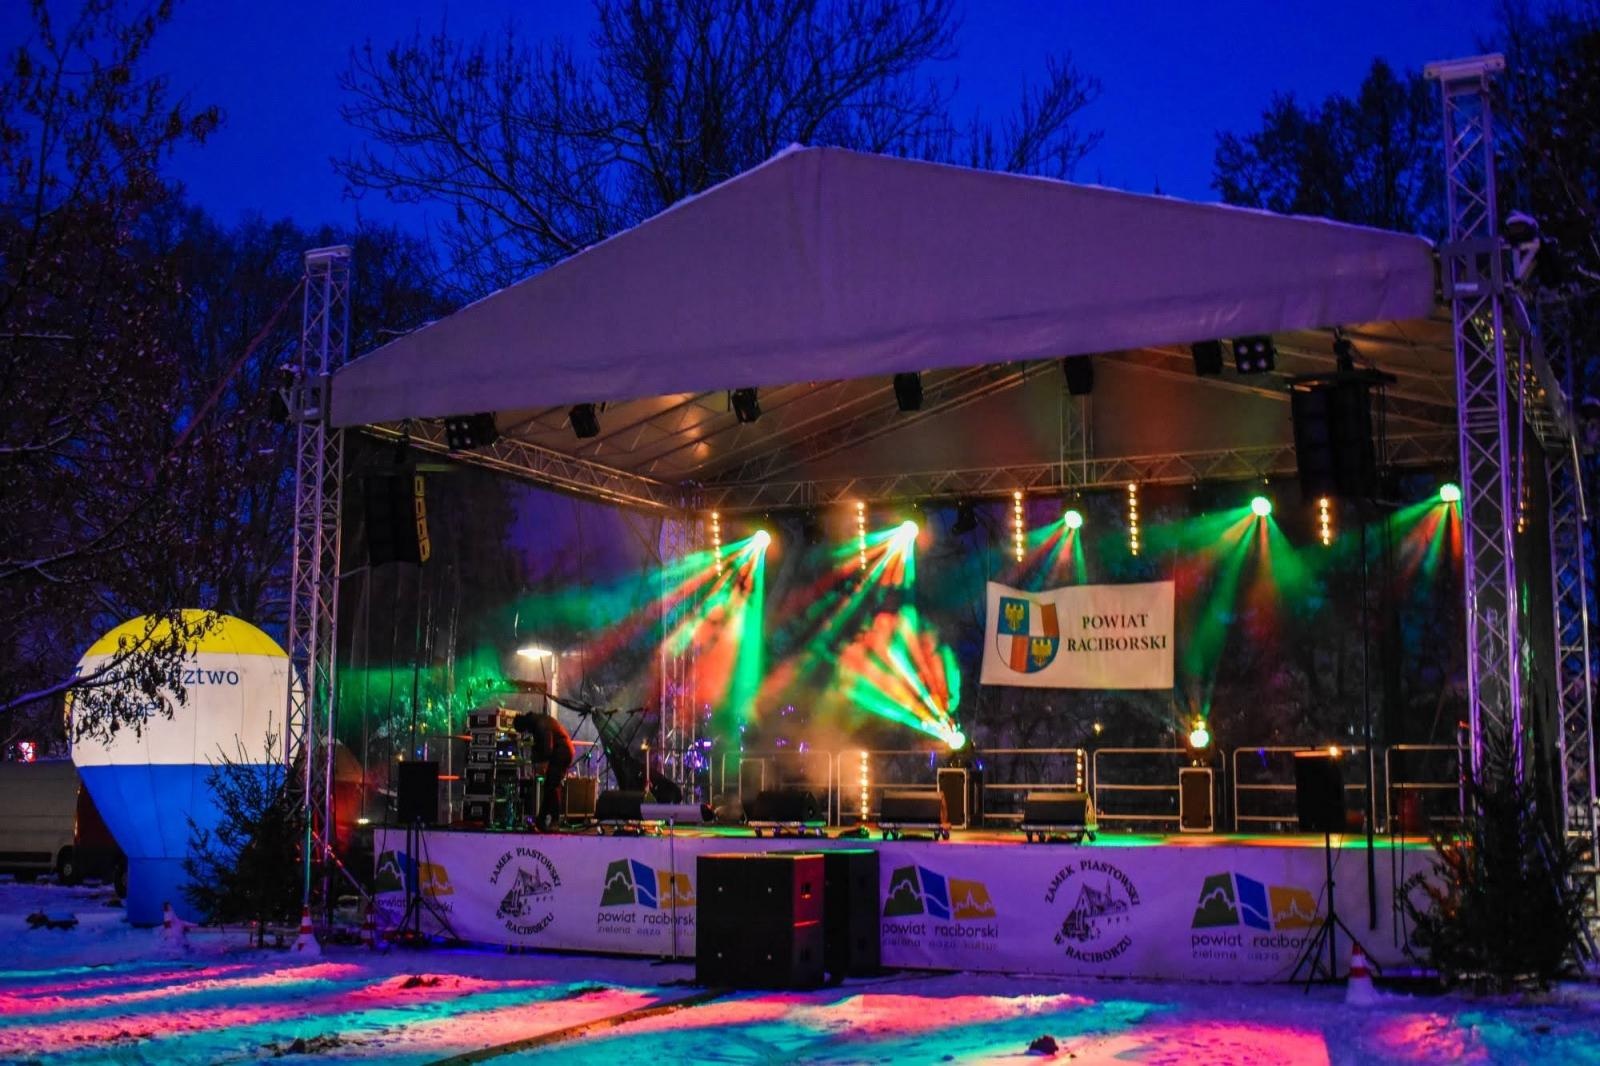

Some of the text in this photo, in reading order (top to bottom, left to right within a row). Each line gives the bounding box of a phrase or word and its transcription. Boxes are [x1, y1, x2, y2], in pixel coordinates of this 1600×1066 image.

[1082, 613, 1149, 630] POWIAT
[1067, 635, 1167, 652] RACIBORSKI
[490, 847, 561, 887] ZAMEK PIASTOWSKI
[1044, 859, 1141, 906] ZAMEK PIASTOWSKI
[505, 912, 555, 936] RACIBORZU
[597, 911, 695, 926] powiat raciborsk
[882, 922, 999, 939] powiat raciborski
[1191, 932, 1242, 949] powiat
[1065, 935, 1133, 964] RACIBORZU
